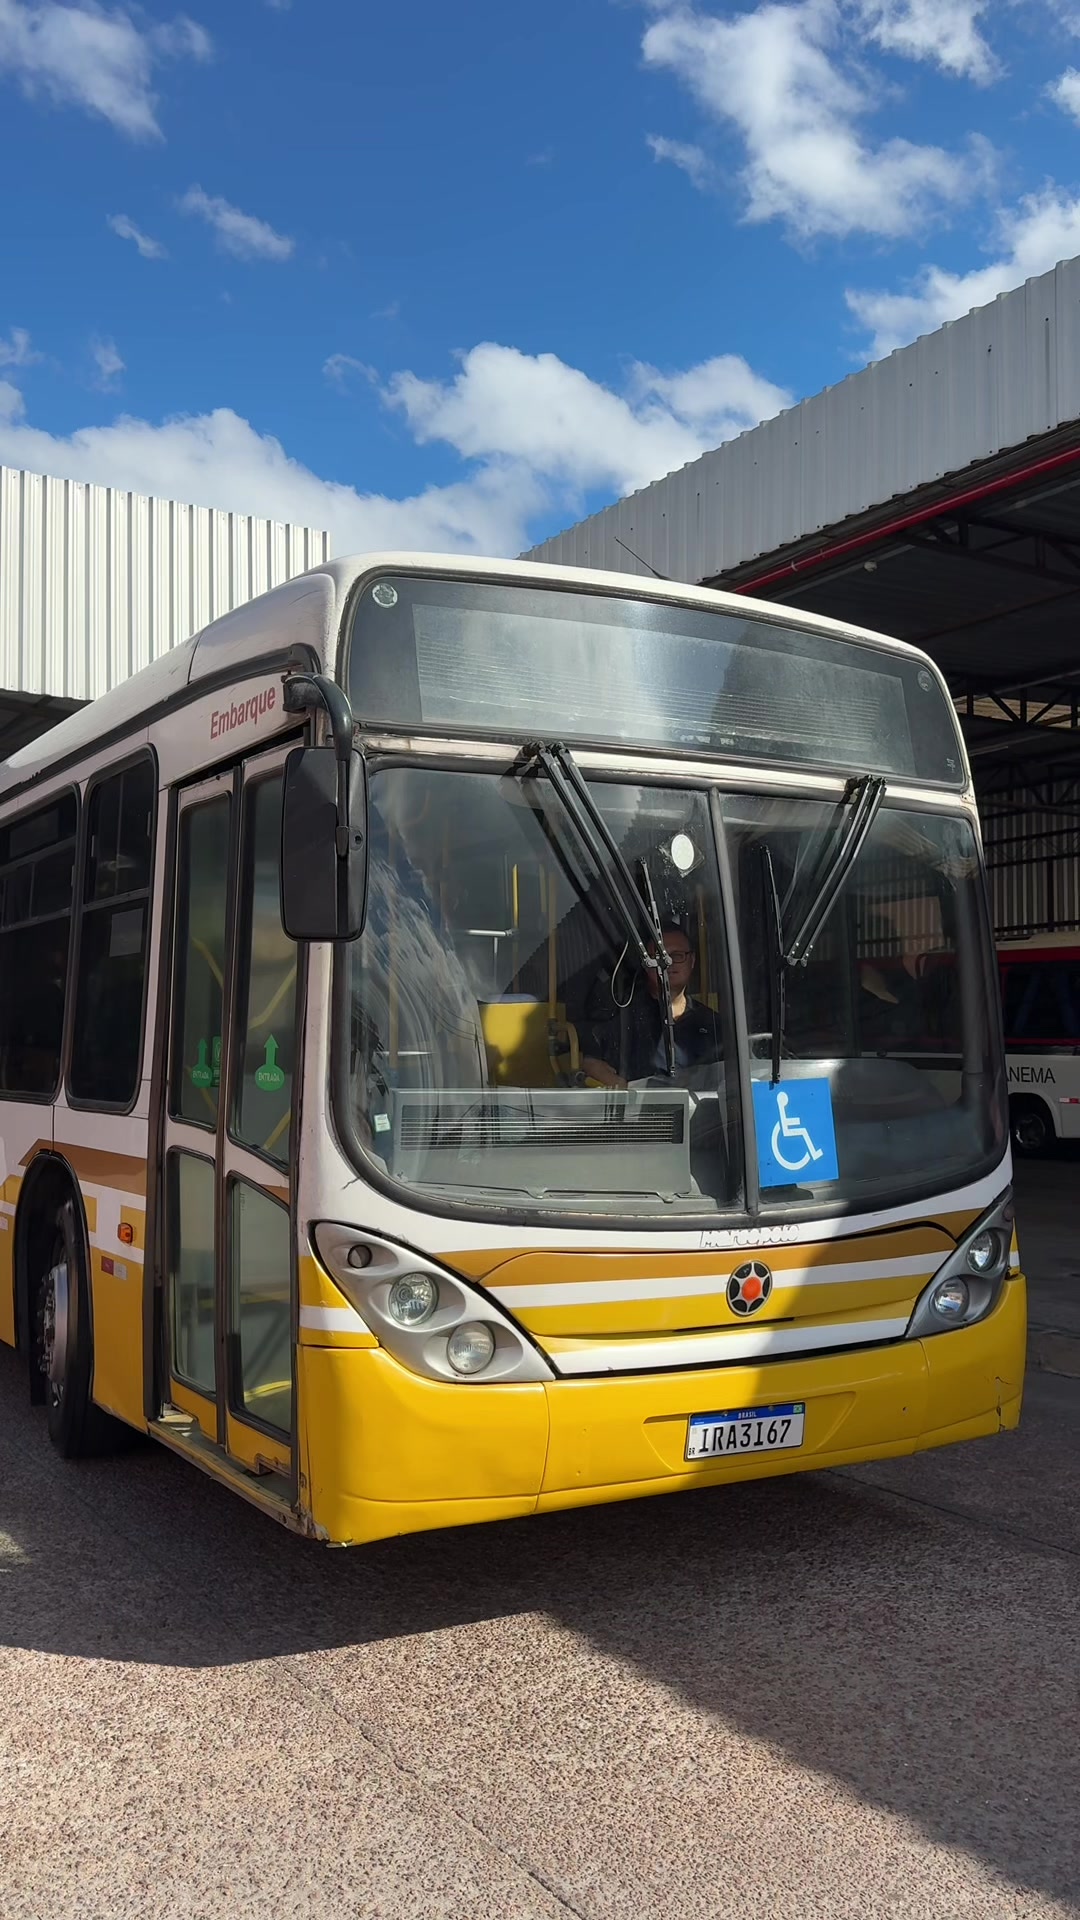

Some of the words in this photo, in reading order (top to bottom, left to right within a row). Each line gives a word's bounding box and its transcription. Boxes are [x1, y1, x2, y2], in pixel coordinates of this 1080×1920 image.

[211, 687, 276, 739] Embarque
[258, 1072, 280, 1082] ENTRADA
[1007, 1066, 1056, 1083] NEMA
[738, 1411, 757, 1419] BRASIL
[698, 1419, 792, 1453] IRA3I67
